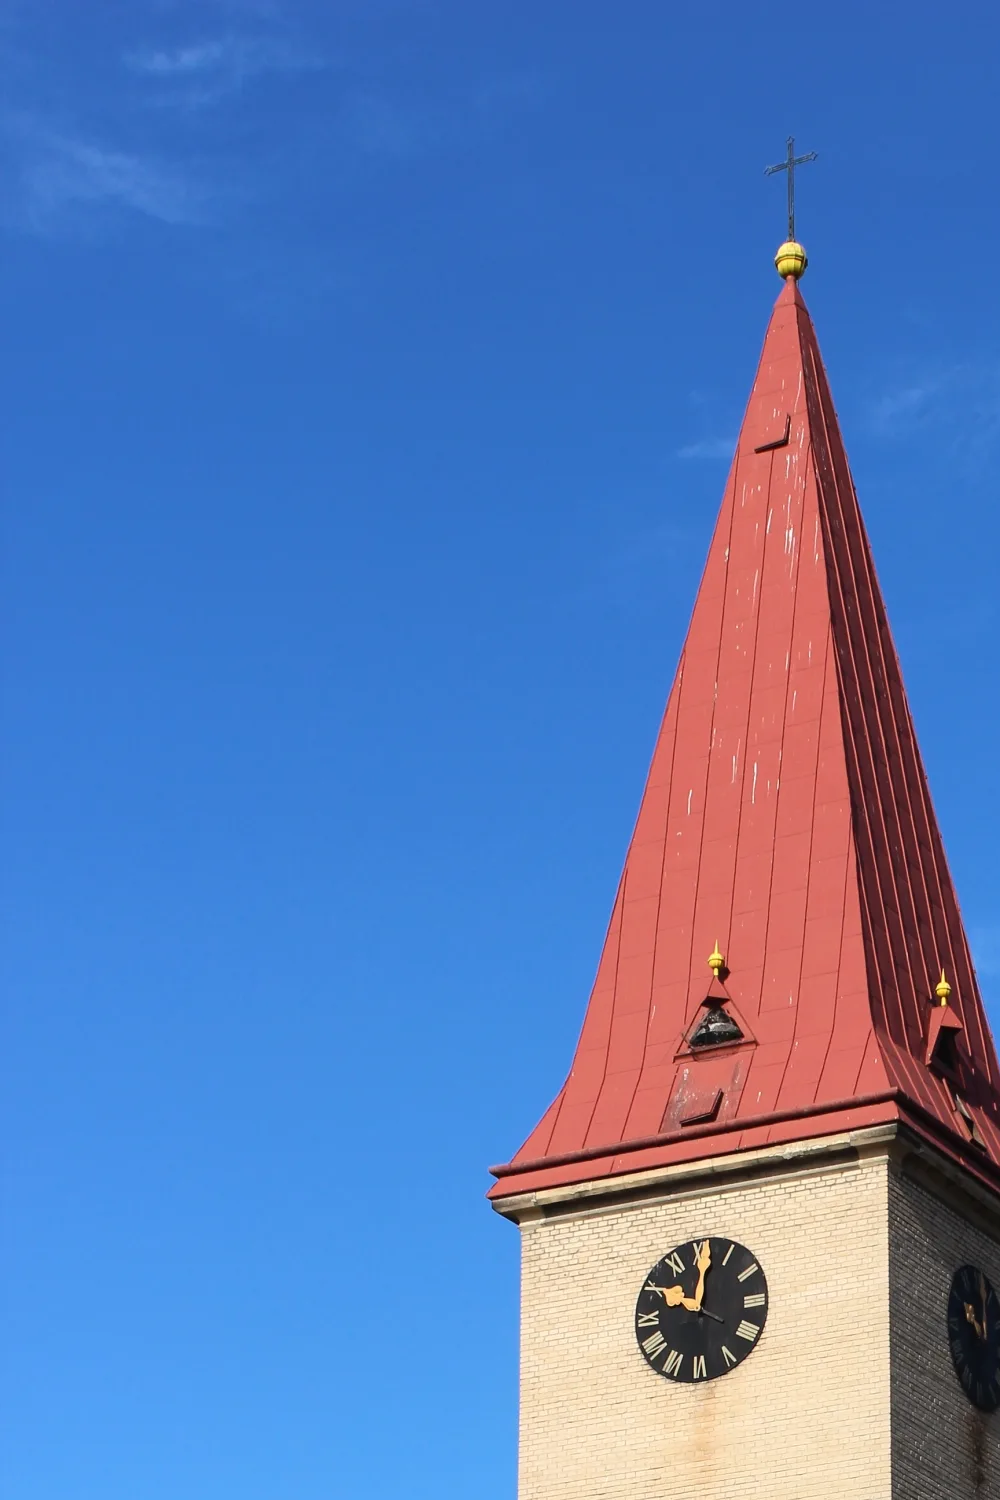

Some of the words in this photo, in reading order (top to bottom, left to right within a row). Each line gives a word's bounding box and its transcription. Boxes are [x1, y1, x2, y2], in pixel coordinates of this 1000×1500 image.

[664, 1251, 686, 1278] XI
[737, 1263, 759, 1283] II
[743, 1293, 766, 1309] III
[638, 1310, 660, 1328] IX
[735, 1319, 760, 1342] IIII
[641, 1330, 668, 1361] VIII
[721, 1345, 738, 1368] V
[662, 1349, 684, 1377] VII
[693, 1355, 707, 1379] VI
